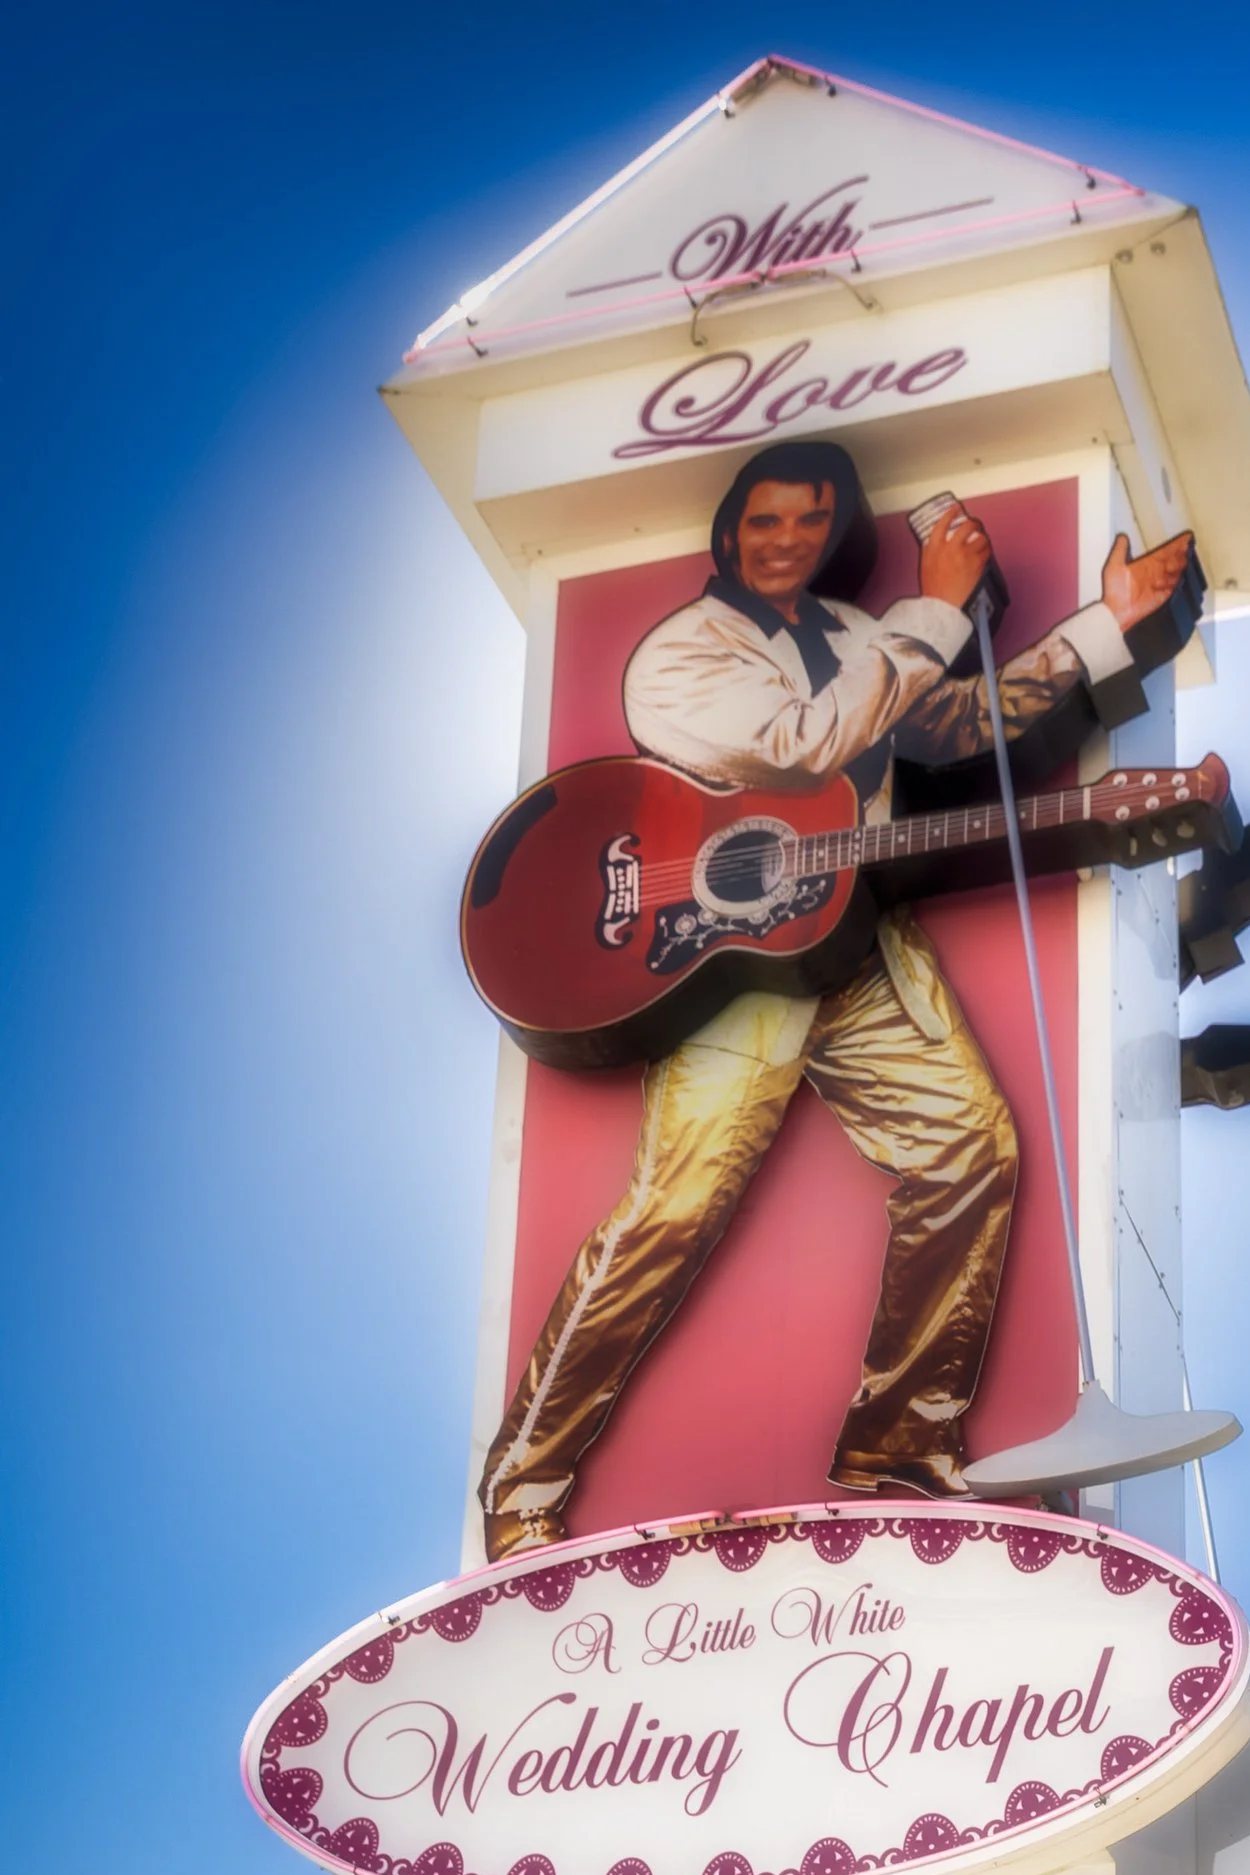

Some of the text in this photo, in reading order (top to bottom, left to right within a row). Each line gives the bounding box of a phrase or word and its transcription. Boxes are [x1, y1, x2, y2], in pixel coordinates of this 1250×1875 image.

[669, 173, 869, 282] With
[611, 338, 969, 460] Love
[552, 1583, 906, 1674] A Little White
[342, 1646, 1116, 1817] Wedding Chapel
